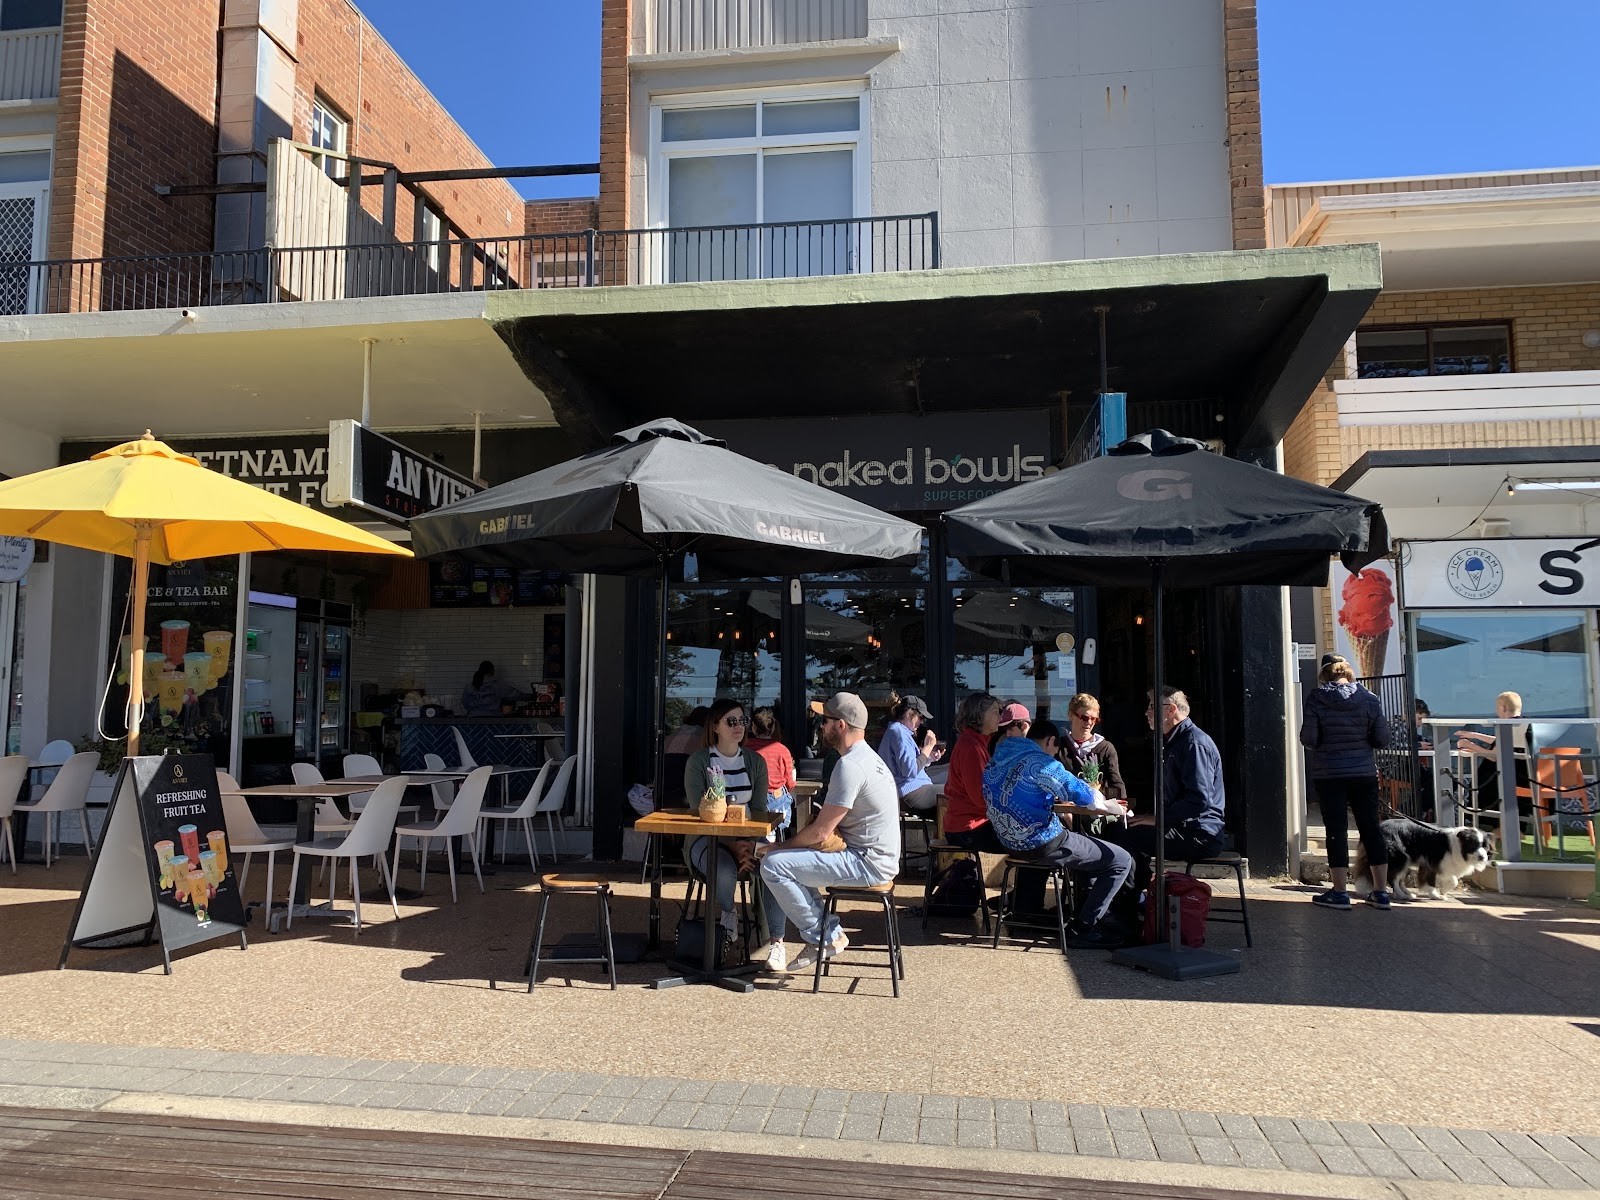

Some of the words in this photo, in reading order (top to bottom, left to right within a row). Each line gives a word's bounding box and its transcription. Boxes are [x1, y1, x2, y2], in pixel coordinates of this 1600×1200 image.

[794, 447, 912, 487] naked
[925, 444, 1045, 485] bowls
[386, 449, 422, 500] AN
[756, 521, 831, 545] GABRIEL
[1451, 555, 1464, 570] ICE
[1466, 550, 1498, 567] CREAM
[165, 587, 174, 597] &
[176, 586, 200, 597] TEA
[203, 585, 229, 597] BAR
[1454, 585, 1464, 594] AT
[1479, 583, 1498, 598] BEACH
[156, 789, 207, 804] REFRESHING
[164, 805, 188, 818] FRUIT
[189, 804, 206, 815] TEA
